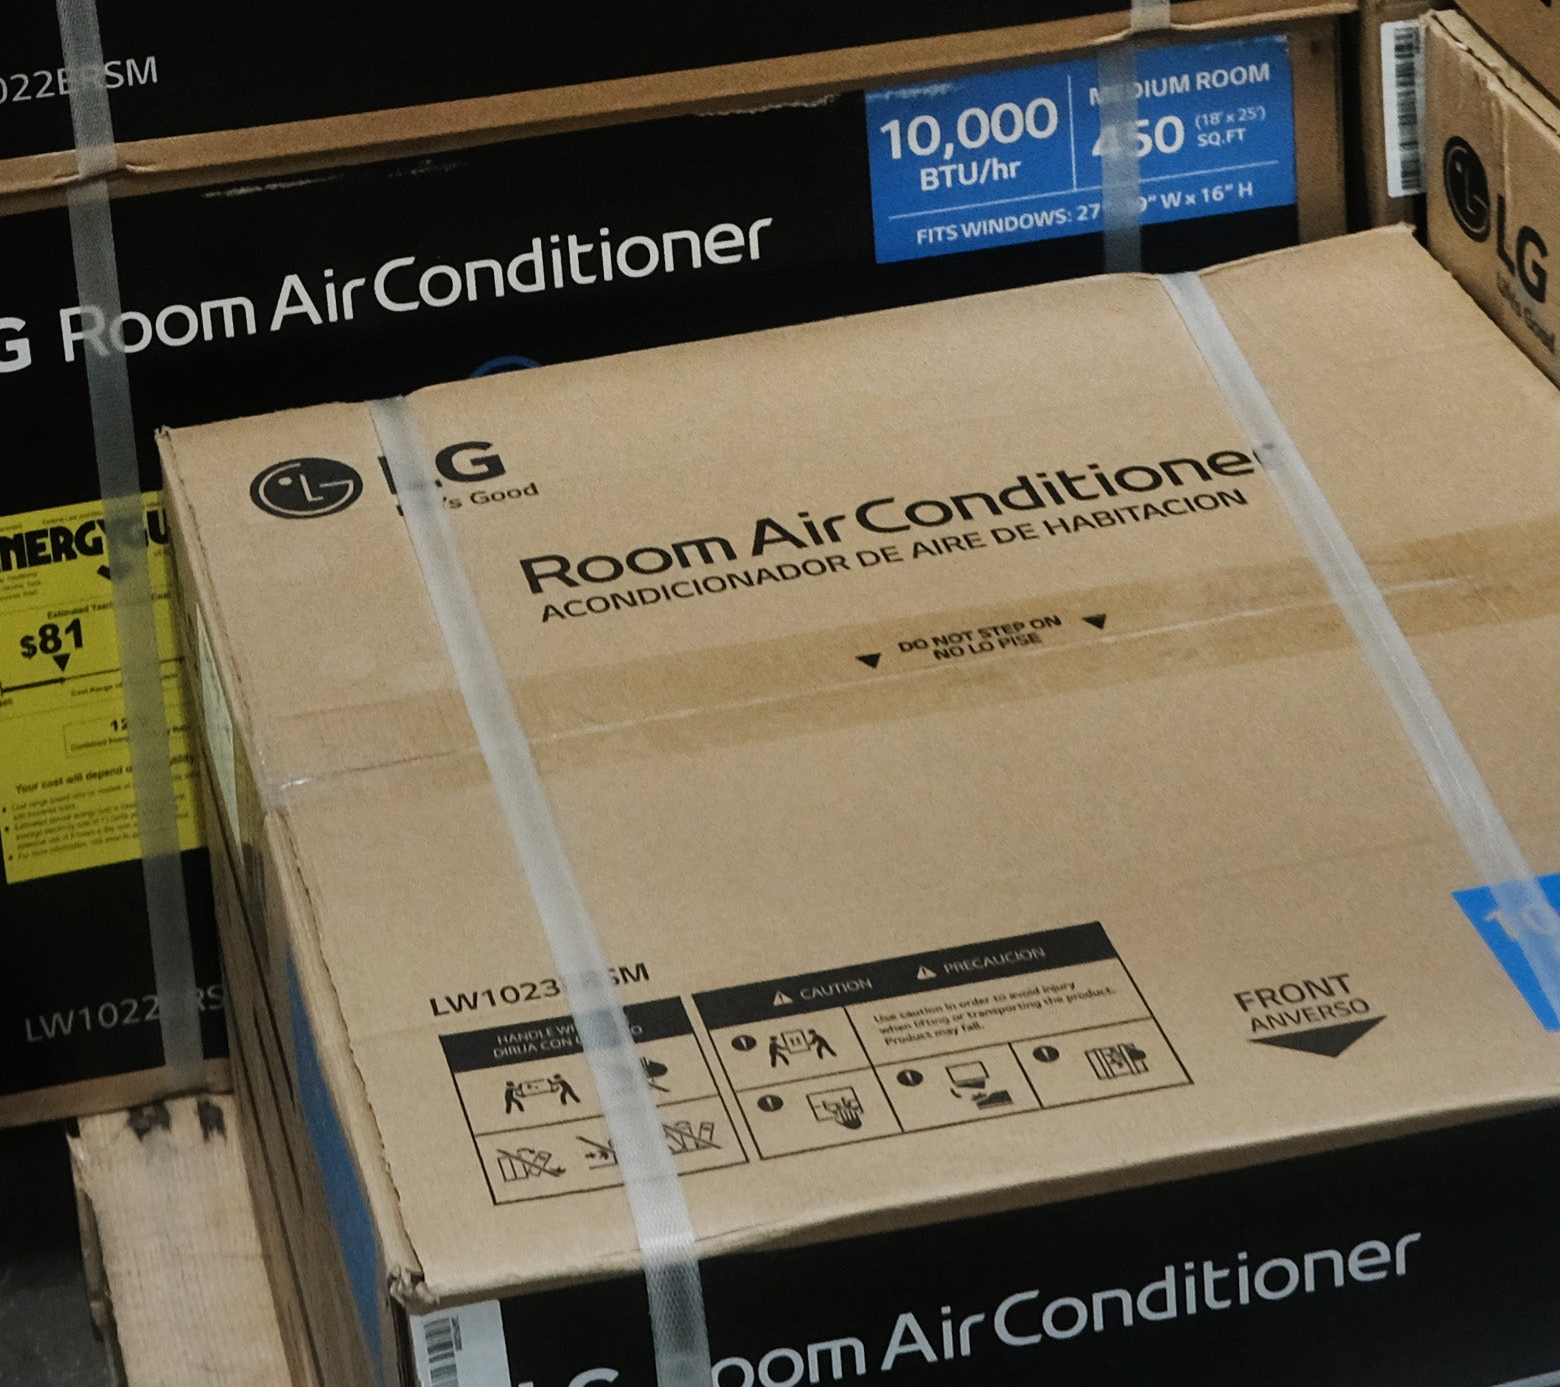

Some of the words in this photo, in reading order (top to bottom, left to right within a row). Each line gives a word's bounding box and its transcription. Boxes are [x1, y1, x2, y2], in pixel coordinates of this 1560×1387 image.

[60, 295, 258, 362] Room
[270, 267, 365, 327] Air
[374, 217, 775, 309] Conditioner
[470, 481, 540, 507] Good
[519, 535, 737, 593] Room
[752, 507, 847, 558] Air
[540, 552, 852, 622] ACONDICIONADOR
[855, 548, 905, 568] DE
[910, 530, 987, 561] AIRE
[992, 522, 1040, 544] DE
[1042, 488, 1249, 535] HABITACION
[20, 618, 84, 659] $81
[898, 638, 930, 653] DO
[932, 633, 974, 650] NOT
[979, 621, 1026, 641] STEP
[1026, 616, 1062, 631] ON
[933, 646, 966, 662] NO
[968, 640, 992, 655] LO
[992, 632, 1042, 651] PISE
[430, 961, 650, 1018] LW1023SM
[798, 978, 874, 1004] CAUTION
[942, 946, 1046, 976] PRECAUCION
[1234, 973, 1352, 1012] FRONT
[1248, 997, 1370, 1034] ANVERSO
